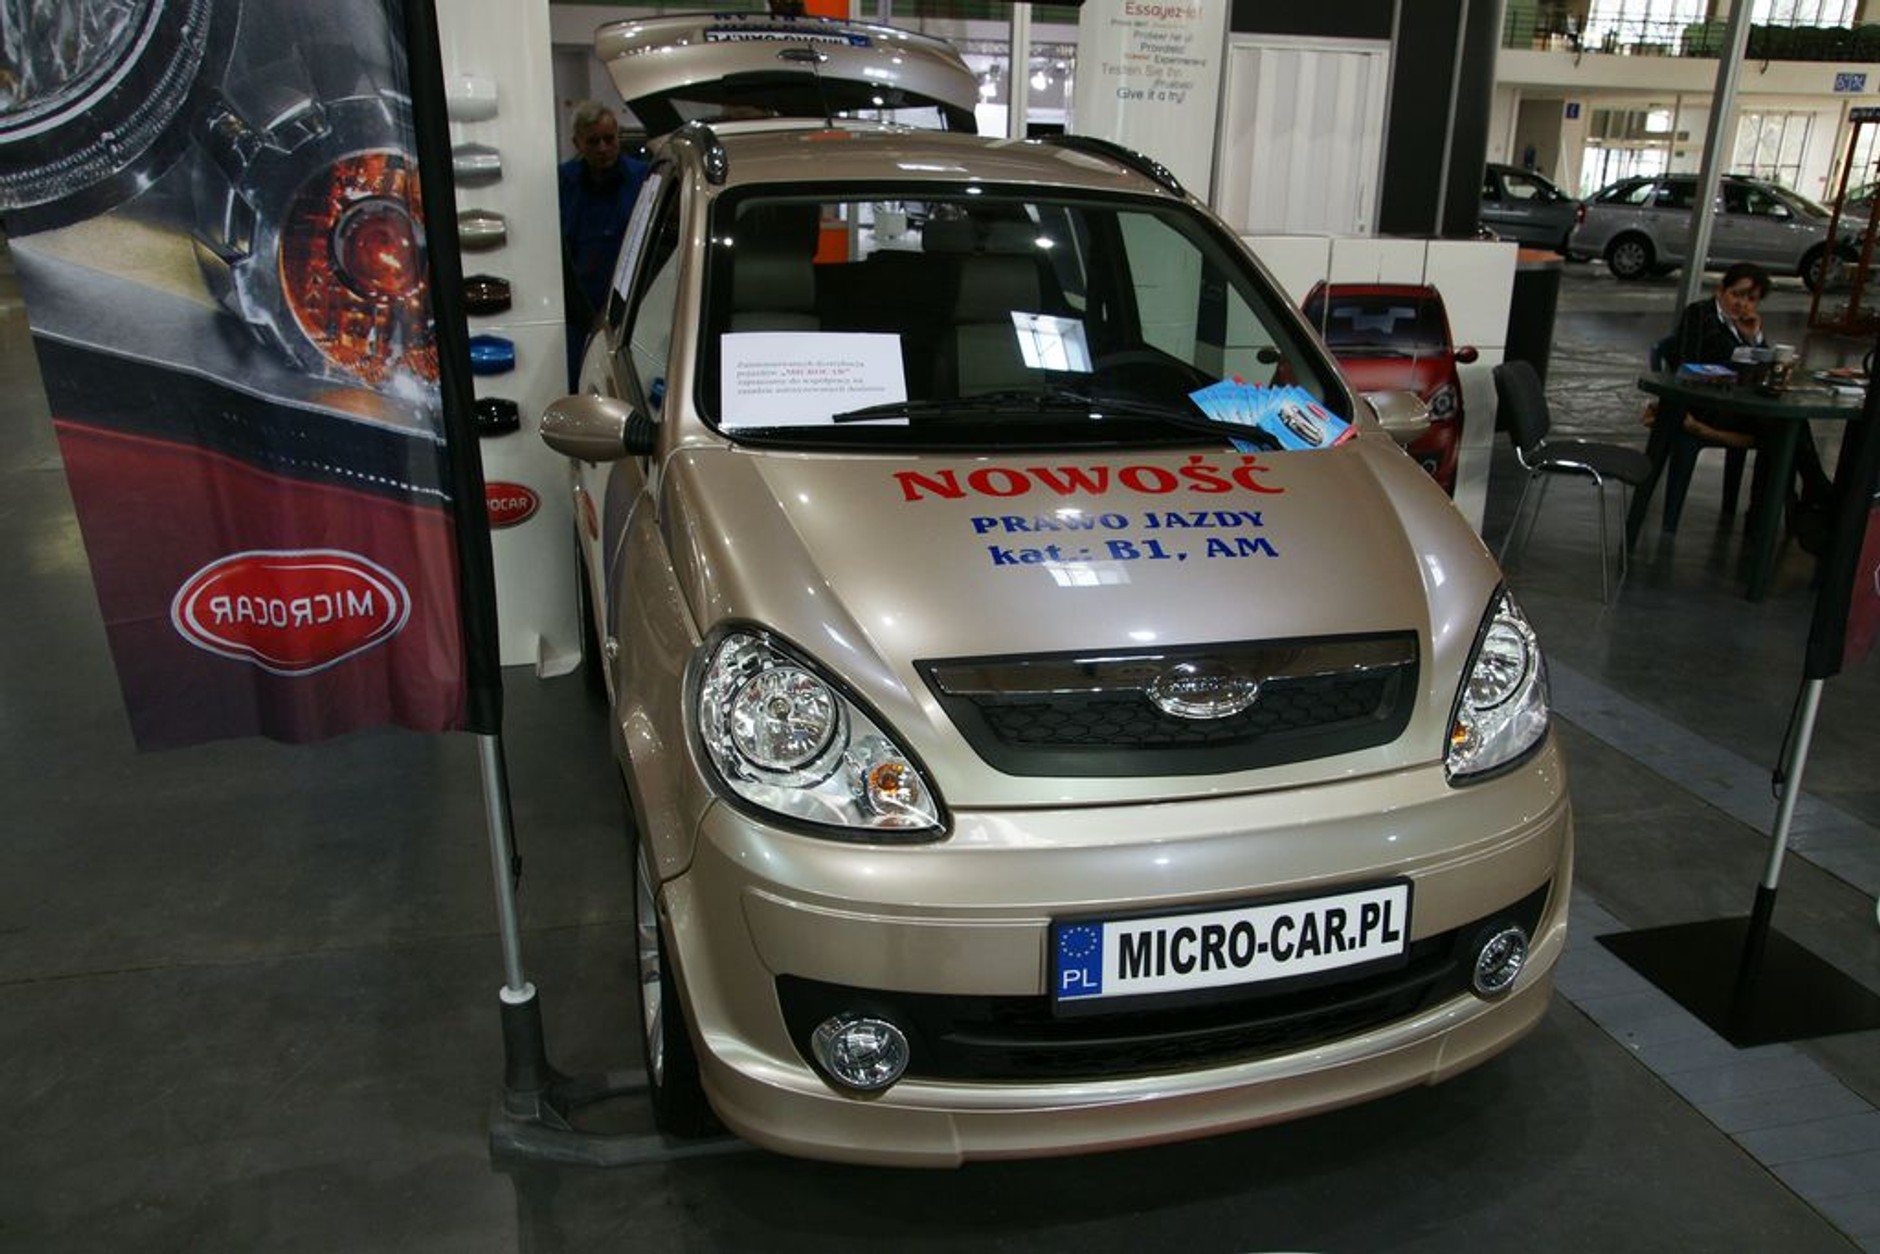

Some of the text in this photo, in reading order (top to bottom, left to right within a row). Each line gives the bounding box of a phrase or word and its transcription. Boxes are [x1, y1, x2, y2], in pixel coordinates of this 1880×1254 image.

[893, 456, 1285, 501] NOWOŚĆ
[970, 511, 1264, 534] PRAWO JAZDY
[1105, 539, 1187, 562] B1,
[1206, 537, 1279, 558] AM
[1118, 899, 1400, 980] MICRO-CAR.PL
[1062, 969, 1097, 990] PL
